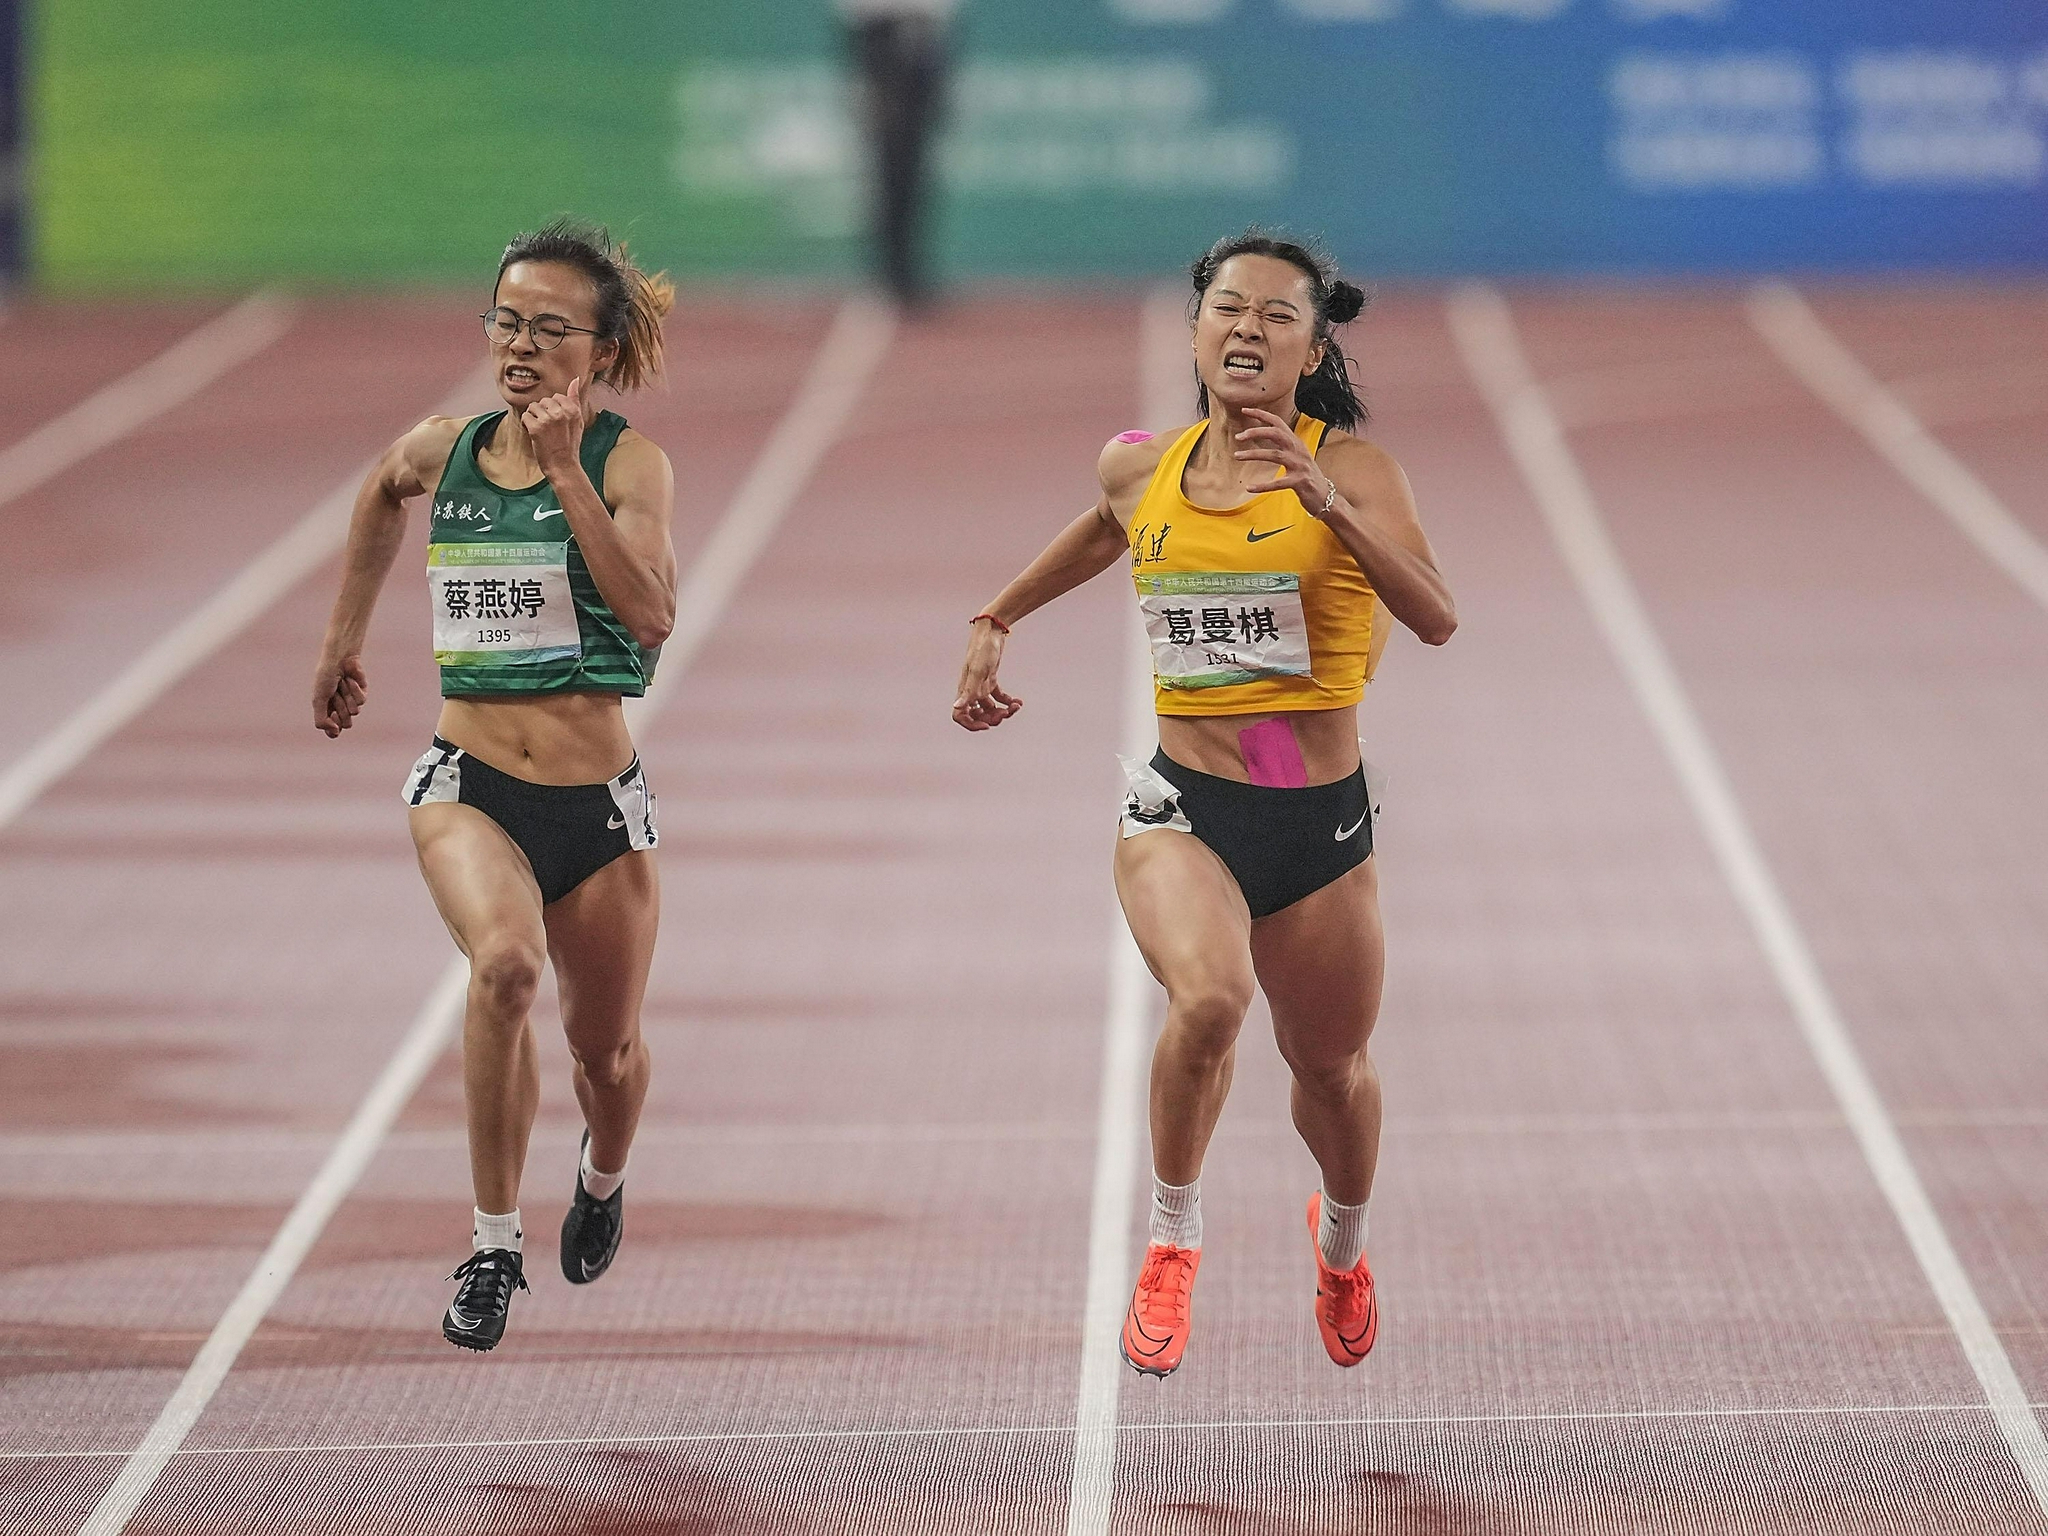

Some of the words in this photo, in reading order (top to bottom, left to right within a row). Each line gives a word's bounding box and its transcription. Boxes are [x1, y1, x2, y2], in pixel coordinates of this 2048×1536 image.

[447, 547, 546, 558] 中华人民共和国第十四届运动会
[443, 579, 545, 620] 蔡燕婷
[1161, 606, 1280, 646] 葛曼棋
[477, 629, 511, 643] 1395
[1205, 653, 1240, 666] 1531
